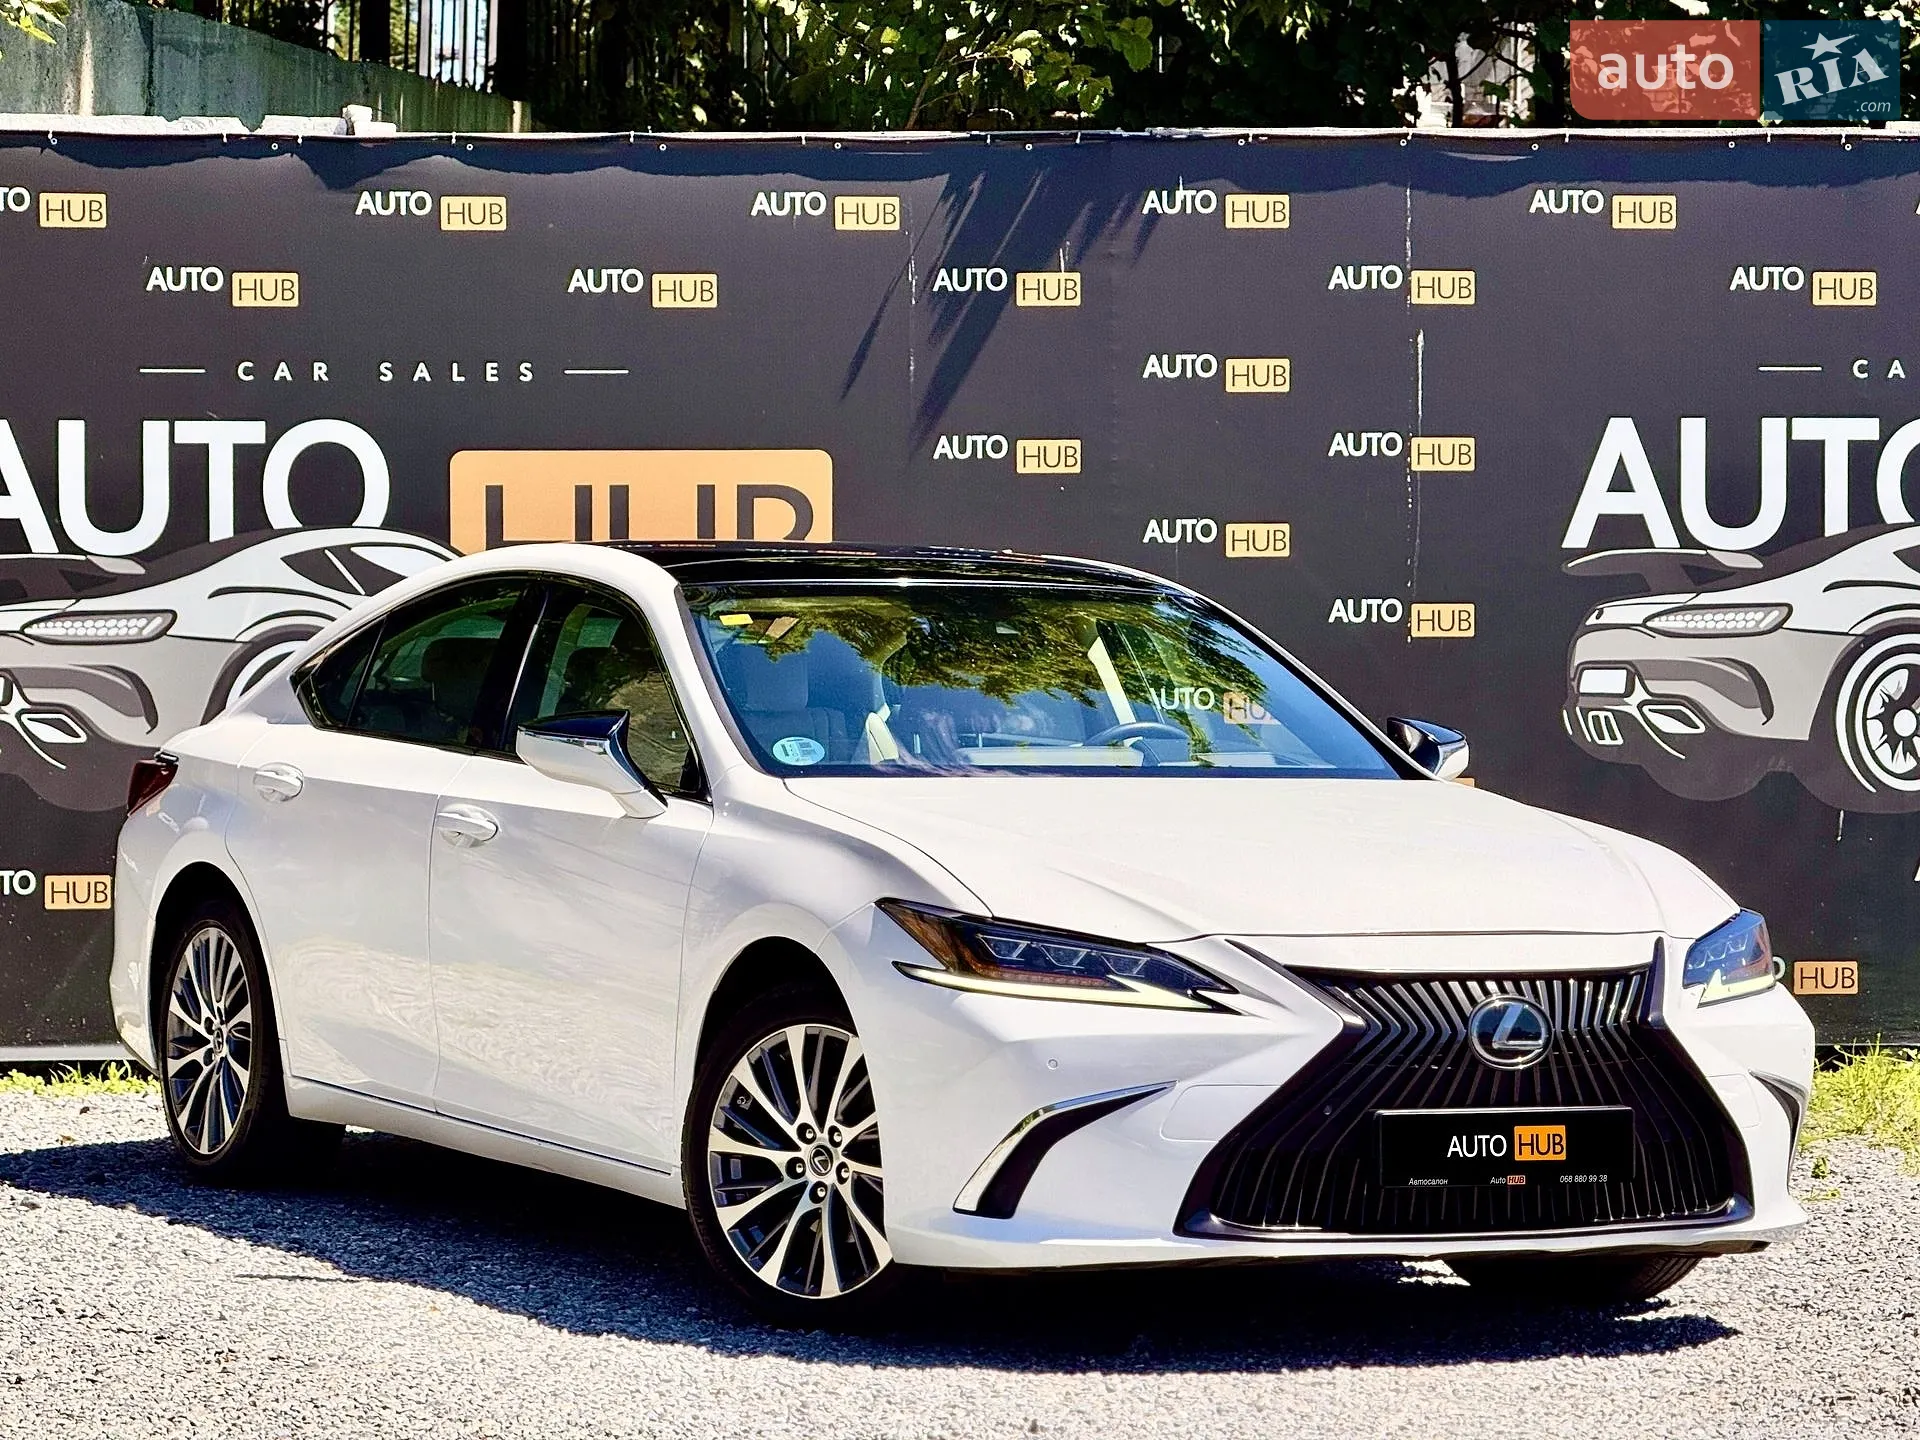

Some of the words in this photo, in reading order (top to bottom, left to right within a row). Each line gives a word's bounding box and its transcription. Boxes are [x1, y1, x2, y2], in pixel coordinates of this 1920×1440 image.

[46, 199, 103, 222] HUB
[355, 191, 432, 215] AUTO
[448, 202, 503, 225] HUB
[751, 192, 826, 216] AUTO
[841, 202, 897, 225] HUB
[1142, 189, 1217, 214] AUTO
[1231, 201, 1286, 222] HUB
[1529, 190, 1604, 213] AUTO
[1618, 201, 1673, 223] HUB
[146, 267, 223, 291] AUTO
[238, 279, 295, 302] HUB
[568, 269, 643, 293] AUTO
[658, 280, 714, 302] HUB
[933, 268, 1007, 291] AUTO
[1023, 278, 1077, 300] HUB
[1328, 265, 1402, 290] AUTO
[1417, 277, 1472, 299] HUB
[1730, 267, 1804, 290] AUTO
[1818, 278, 1873, 300] HUB
[237, 361, 329, 382] CAR
[379, 361, 534, 382] SALES
[1143, 354, 1217, 378] AUTO
[1231, 365, 1286, 387] HUB
[933, 435, 1008, 459] AUTO
[1023, 446, 1077, 467] HUB
[1328, 432, 1402, 456] AUTO
[1417, 444, 1471, 465] HUB
[1143, 518, 1217, 543] AUTO
[1231, 530, 1286, 551] HUB
[1329, 599, 1402, 623] AUTO
[1417, 610, 1472, 631] HUB
[51, 881, 108, 903] HUB
[1800, 967, 1855, 989] HUB
[1447, 1134, 1507, 1158] AUTO
[1518, 1133, 1565, 1156] HUB
[1408, 1177, 1448, 1186] Автосалон
[1490, 1176, 1506, 1184] Auto
[1508, 1176, 1524, 1184] HUB
[1560, 1174, 1573, 1183] 068
[1574, 1174, 1587, 1183] 880
[1588, 1174, 1598, 1183] 99
[1599, 1174, 1608, 1183] 38
